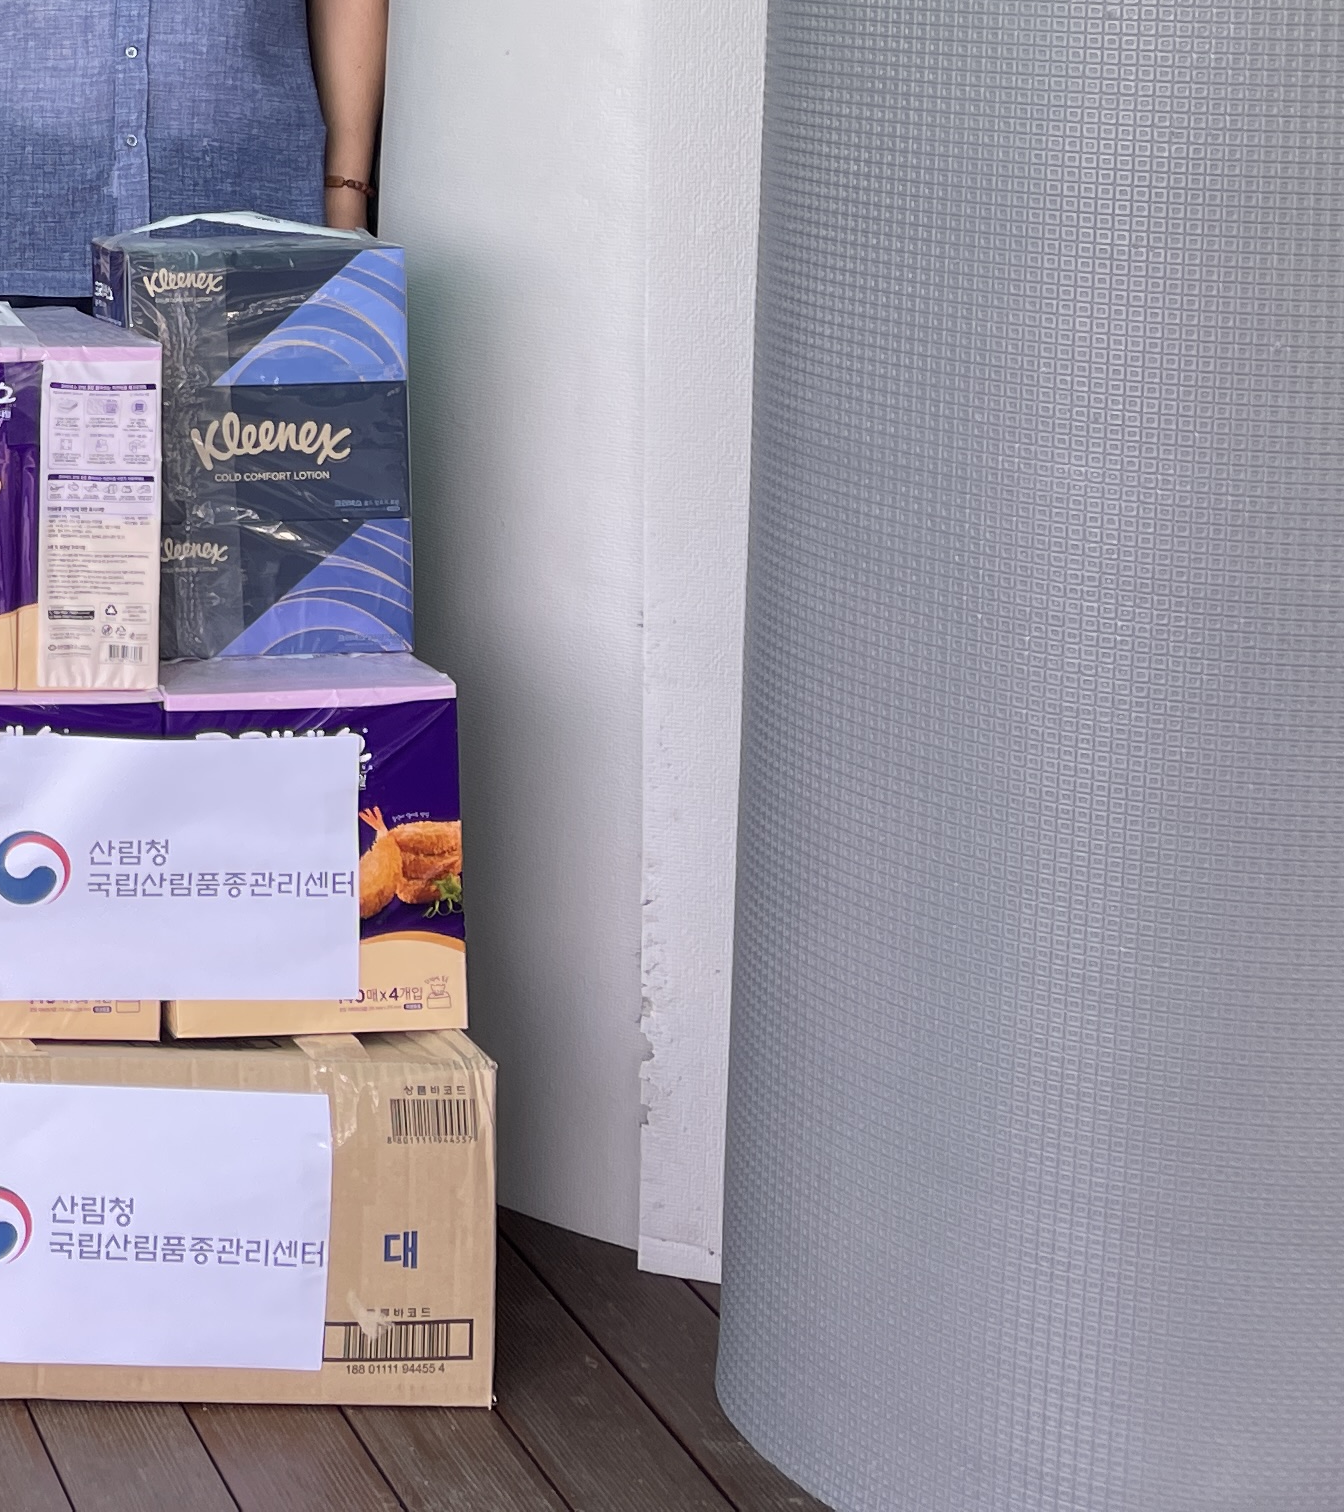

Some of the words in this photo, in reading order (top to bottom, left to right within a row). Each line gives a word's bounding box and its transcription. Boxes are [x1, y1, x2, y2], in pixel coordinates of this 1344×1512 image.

[143, 268, 223, 297] Kleenex
[190, 412, 353, 471] Kleenex
[214, 472, 242, 482] COLD
[243, 471, 292, 482] COMFORT
[293, 470, 331, 480] LOTION
[160, 538, 229, 565] leenex
[89, 839, 169, 867] 산림청
[87, 870, 355, 899] 국립산림품종관리센터
[51, 1195, 134, 1228] 산림청
[49, 1231, 325, 1268] 국립산림품종관리센터
[384, 1231, 418, 1269] 대
[346, 1364, 366, 1375] 188
[368, 1363, 399, 1374] 01111
[402, 1363, 436, 1374] 94455
[438, 1363, 445, 1373] 4
